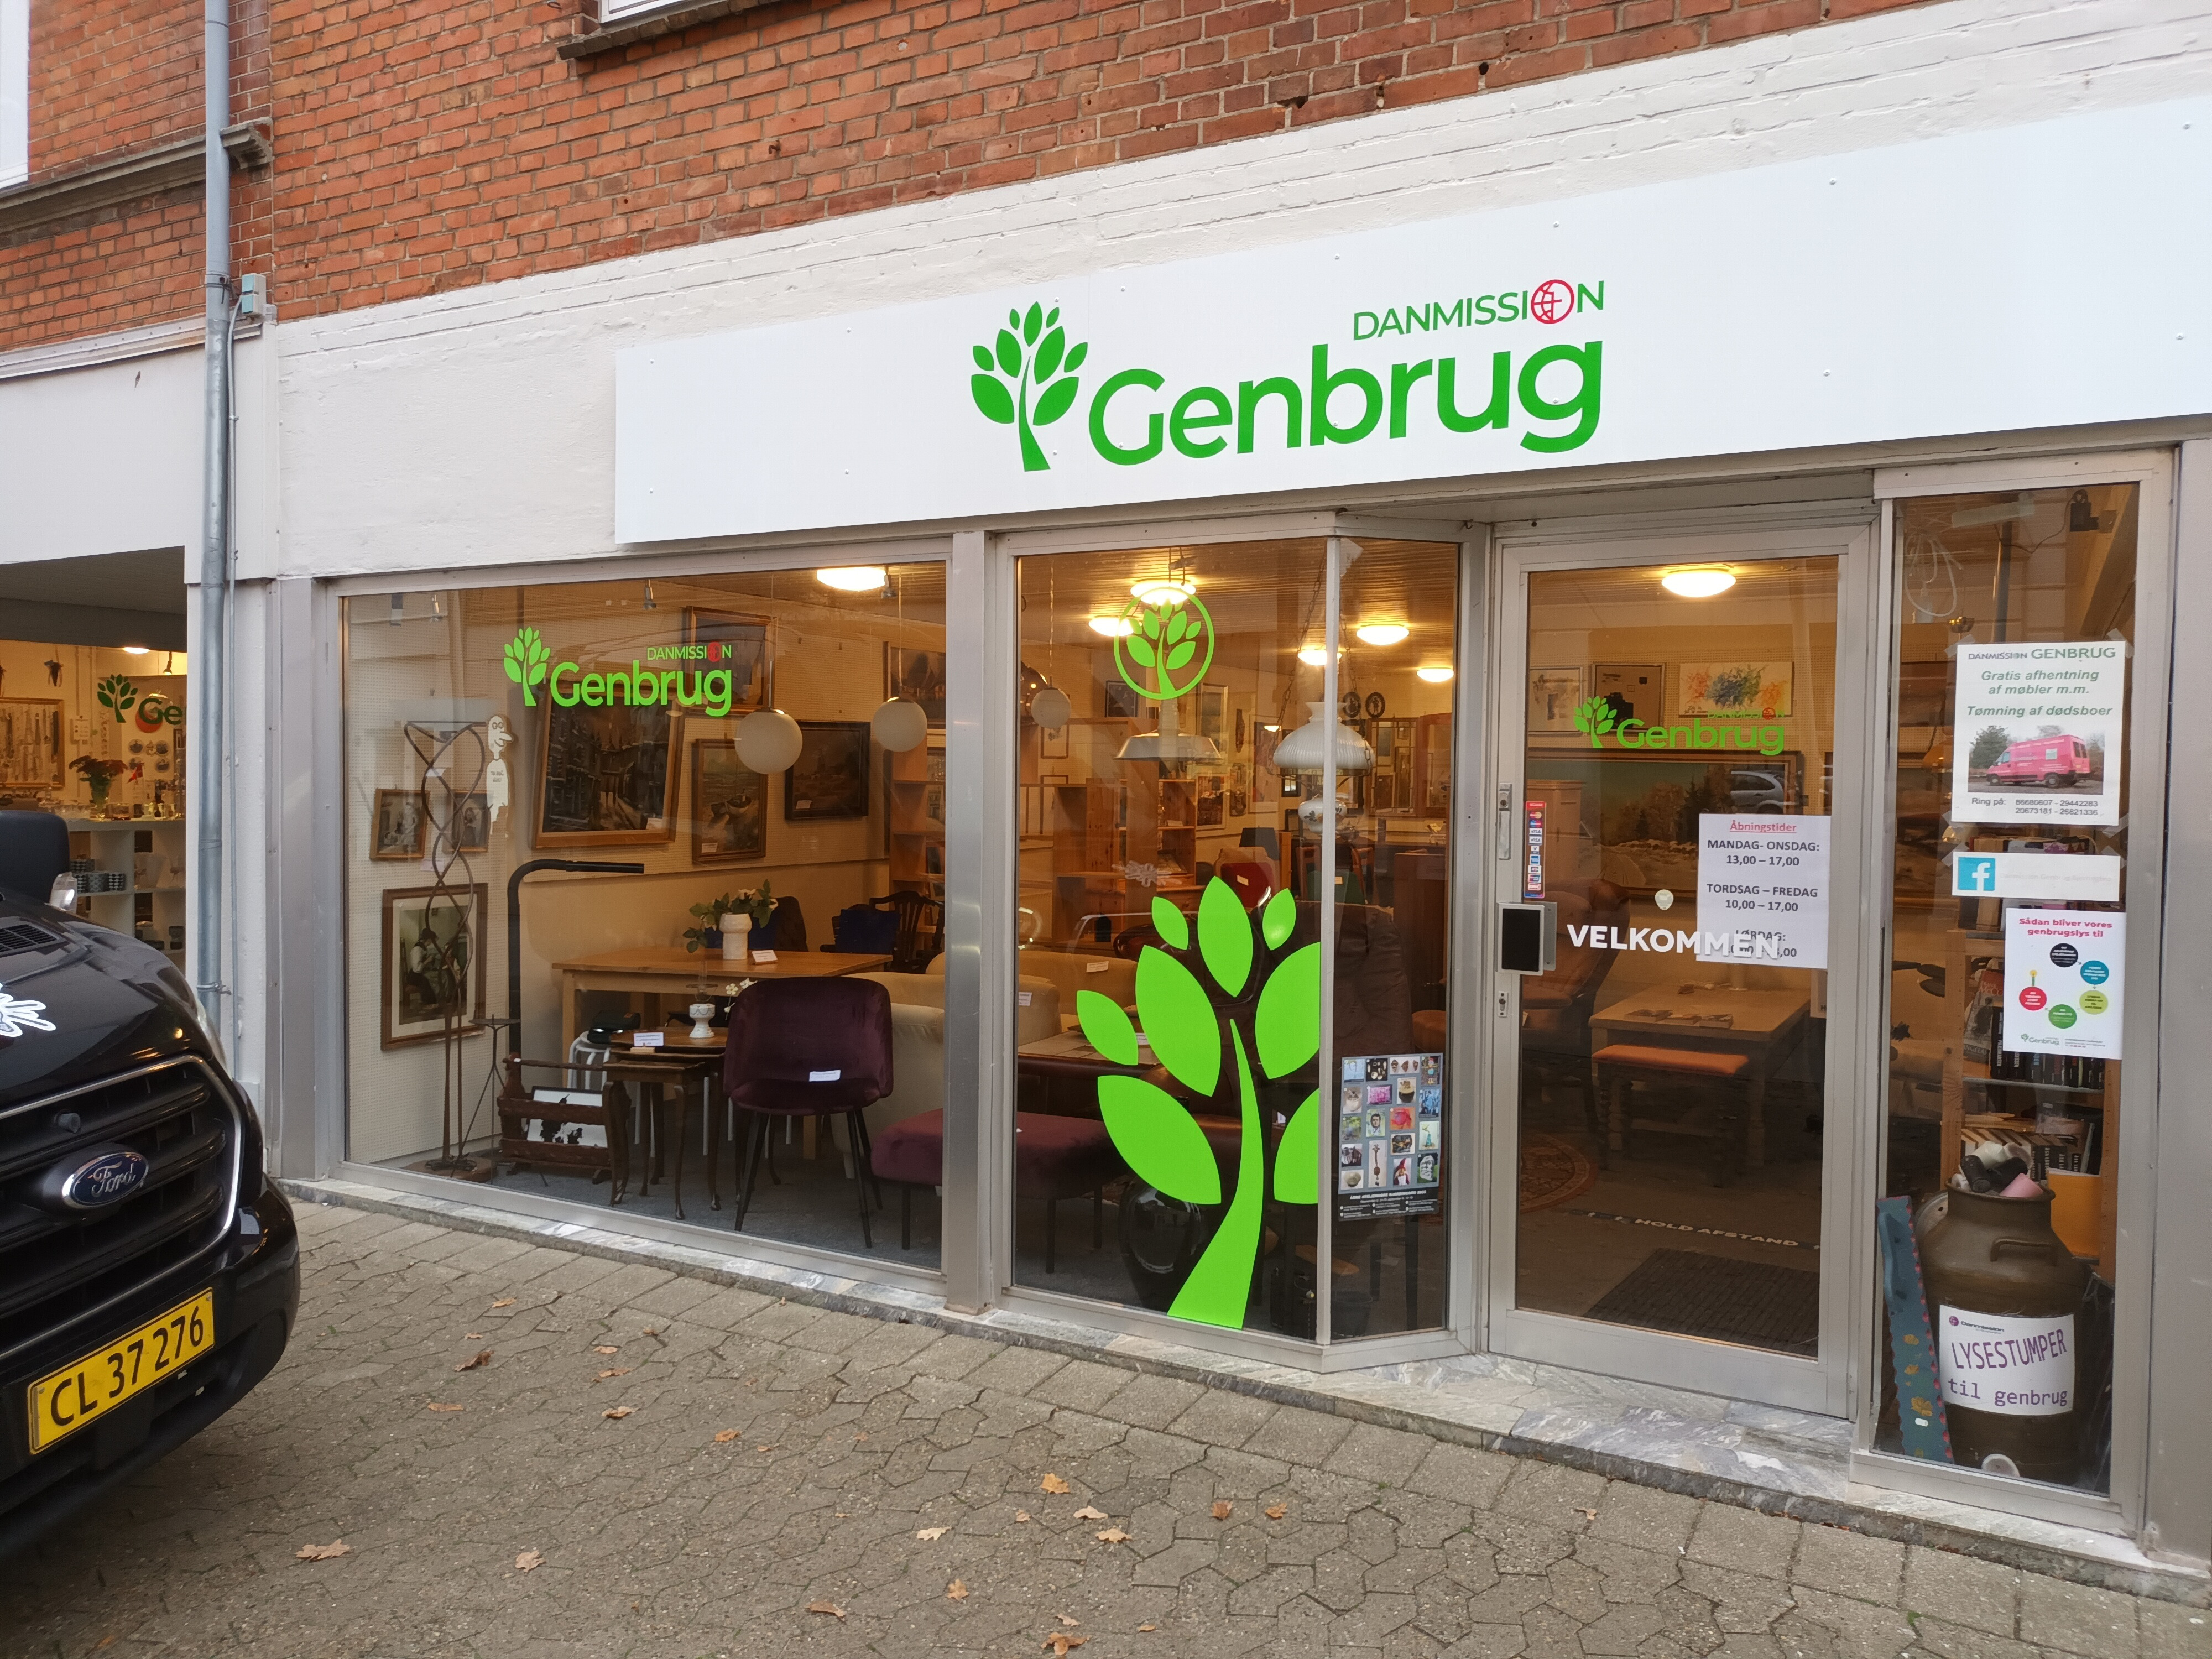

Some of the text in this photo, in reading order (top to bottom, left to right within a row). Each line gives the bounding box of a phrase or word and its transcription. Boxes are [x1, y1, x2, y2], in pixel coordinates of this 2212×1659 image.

[1353, 279, 1605, 341] DANMISSION
[1088, 341, 1603, 466] Genbrug
[647, 641, 732, 662] DANMISSION
[2031, 647, 2116, 659] GENBRUG
[1981, 670, 2099, 682] Gratis afhentning
[550, 660, 732, 717] Genbrug
[1988, 685, 2002, 695] af
[2005, 684, 2053, 695] møbler
[138, 697, 186, 726] Ge
[1967, 706, 2112, 718] Tømning af dødsboer
[1616, 718, 1785, 755] Genbrug
[1730, 820, 1797, 832] Åbningstider
[1708, 840, 1820, 851] MANDAG- ONSDAG:
[1726, 855, 1756, 866] 13,00
[1769, 857, 1799, 867] 17,00
[1707, 884, 1760, 894] TORDSAG
[1773, 887, 1818, 897] FREDAG
[1725, 900, 1755, 910] 10,00
[1768, 902, 1798, 912] 17,00
[2027, 928, 2090, 937] genbrugslys
[1567, 924, 1780, 959] VELKOMMEN
[2028, 1037, 2059, 1046] Genbrug
[91, 1161, 136, 1198] Ford
[1635, 1218, 1693, 1231] HOLD
[1951, 1329, 2067, 1369] LYSESTUMPER
[50, 1305, 204, 1426] CL 37 276
[1948, 1378, 2068, 1407] til genbrug
